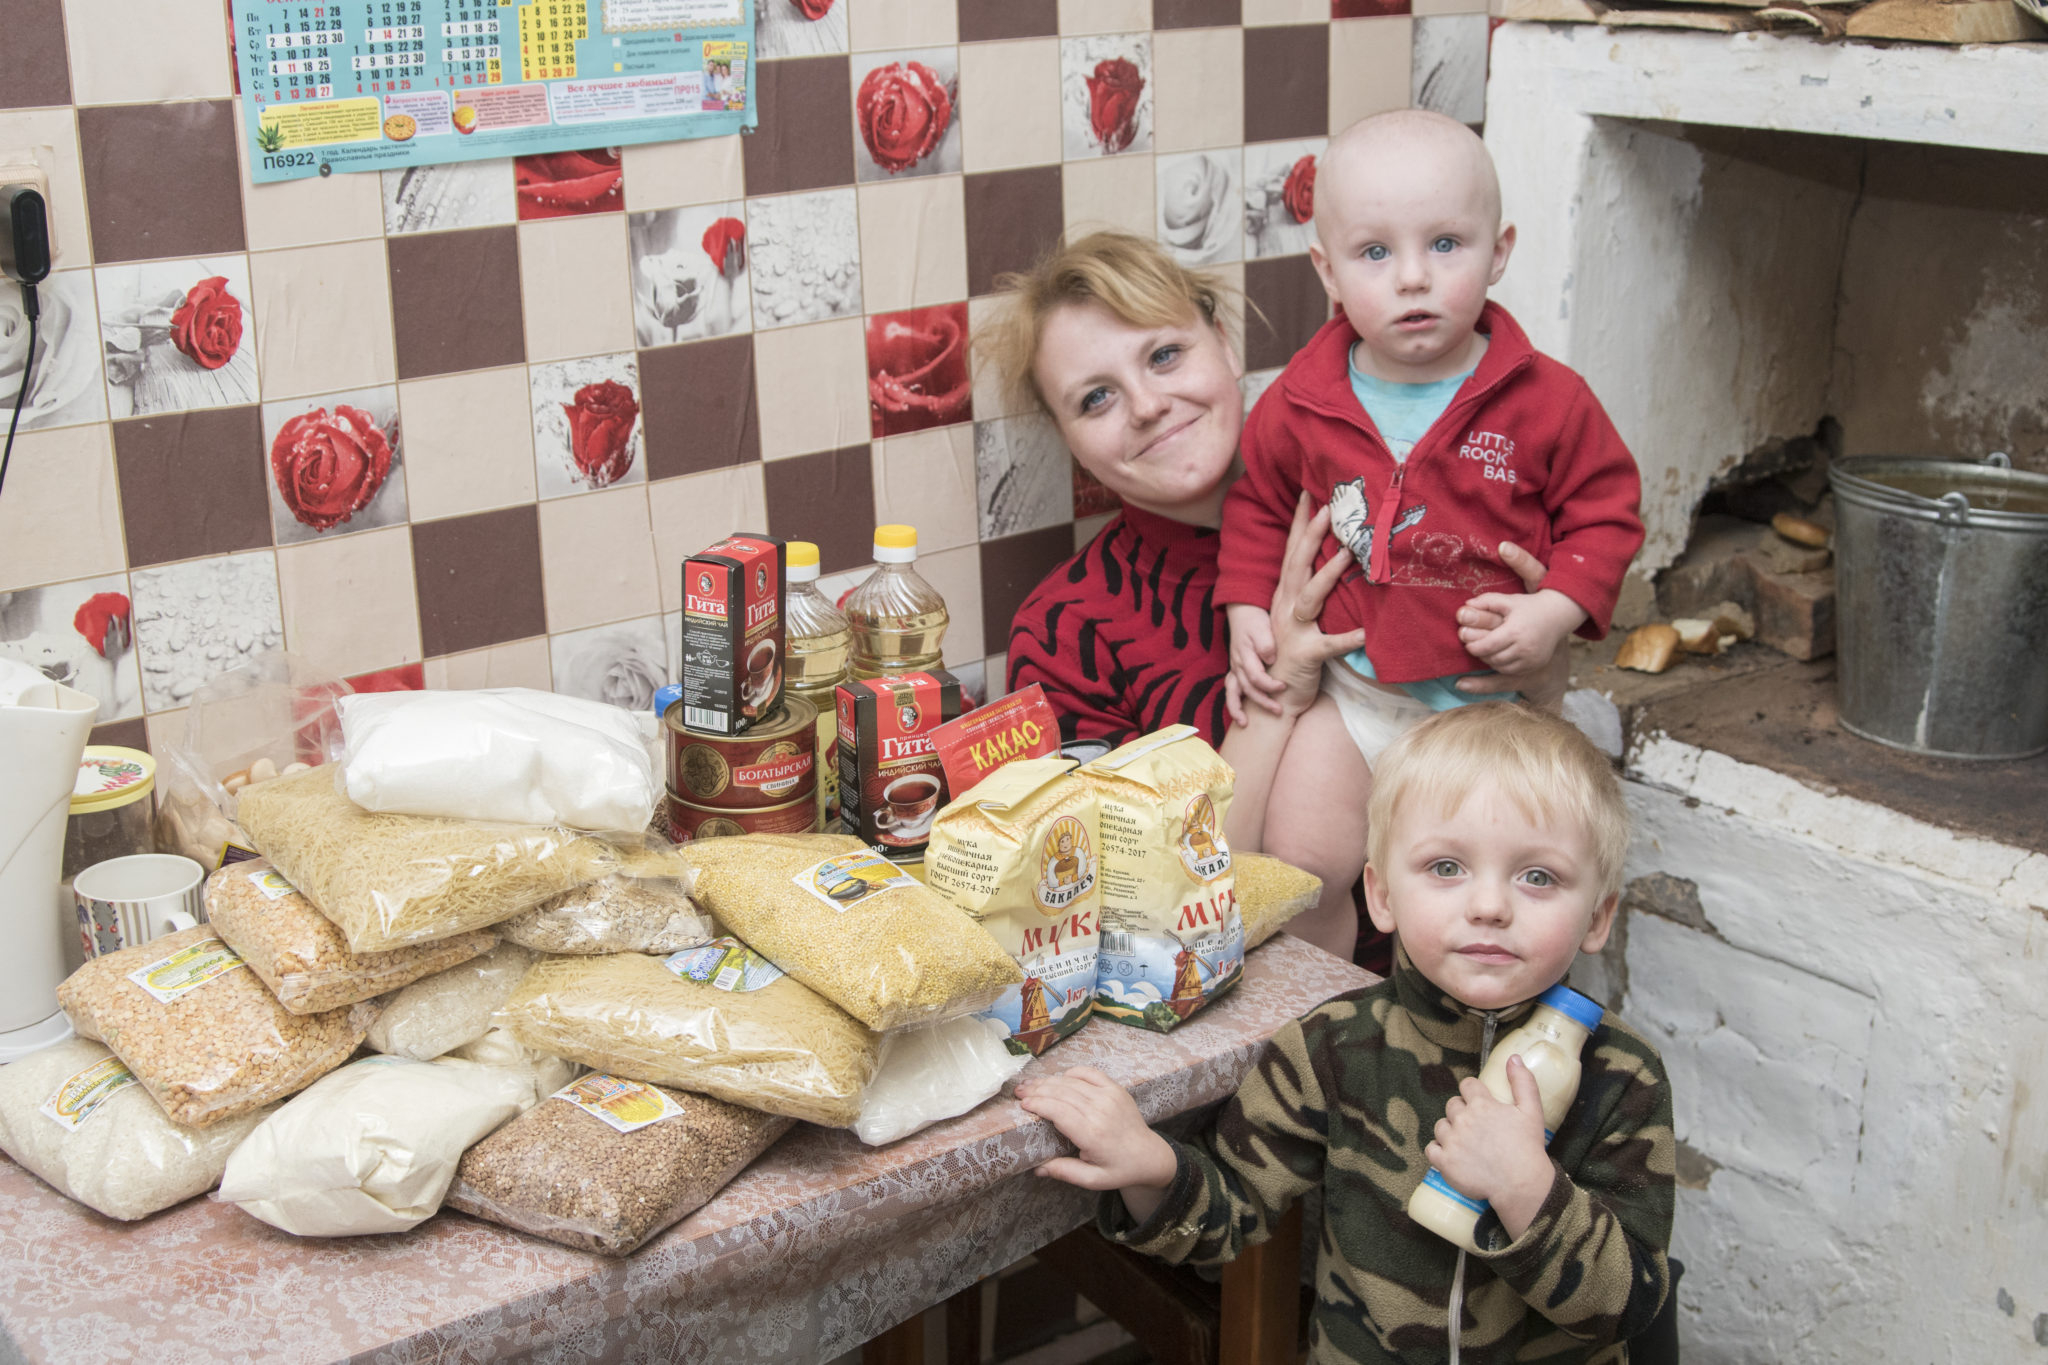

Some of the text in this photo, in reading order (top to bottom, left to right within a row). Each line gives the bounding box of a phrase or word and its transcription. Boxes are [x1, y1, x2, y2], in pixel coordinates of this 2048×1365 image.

[300, 6, 340, 18] 14 21 28
[382, 3, 390, 12] 12
[397, 2, 405, 12] 19
[411, 1, 420, 11] 26
[549, 4, 585, 15] 15 22 29
[383, 16, 391, 26] 13
[397, 15, 407, 25] 20
[412, 14, 420, 24] 27
[460, 10, 496, 20] 10 17 24
[300, 22, 310, 31] 15
[316, 21, 326, 30] 22
[331, 20, 341, 30] 29
[461, 22, 497, 33] 11 18 25
[550, 17, 586, 27] 16 23 30
[384, 28, 422, 39] 14 21 28
[537, 30, 585, 41] 10 17 24 31
[250, 40, 259, 50] Ср
[302, 36, 310, 45] 16
[317, 34, 327, 44] 23
[332, 33, 342, 42] 30
[384, 43, 392, 52] 15
[399, 42, 408, 51] 22
[413, 41, 423, 50] 29
[461, 35, 498, 46] 12 19 26
[462, 48, 497, 59] 13 20 27
[538, 43, 573, 53] 11 18 25
[250, 54, 263, 62] Чт
[287, 50, 296, 59] 10
[303, 49, 310, 58] 17
[318, 48, 328, 57] 24
[385, 56, 393, 65] 16
[399, 55, 409, 63] 23
[414, 54, 423, 62] 30
[538, 55, 574, 66] 12 19 26
[288, 64, 296, 72] 11
[304, 62, 312, 71] 18
[319, 61, 329, 70] 25
[463, 60, 499, 71] 14 21 28
[371, 66, 423, 79] 10 17 24 31
[464, 72, 500, 84] 15 22 29
[539, 67, 574, 78] 13 20 27
[289, 76, 298, 86] 12
[305, 75, 313, 84] 19
[320, 74, 330, 84] 26
[372, 80, 410, 92] 11 18 25
[587, 84, 622, 92] лучшее
[625, 77, 676, 88] любимым!
[290, 87, 329, 99] 13 20 27
[674, 84, 700, 95] ПР015
[322, 151, 410, 163] Православные праздники
[342, 147, 378, 155] Календарь
[263, 152, 315, 169] П6922
[1459, 445, 1509, 466] ROCK
[687, 594, 725, 614] Гита
[747, 599, 775, 626] Гита
[685, 616, 716, 626] ИНДИЙСКИЙ
[838, 718, 855, 742] Гита
[900, 733, 928, 741] принцес
[882, 738, 935, 759] Гита
[739, 756, 811, 781] БОГАТЫРСКАЯ
[878, 762, 927, 777] ИНДИЙСКИЙ
[766, 779, 796, 790] СВИНИНА
[1100, 822, 1142, 836] опекарная
[1119, 836, 1138, 846] сорт
[1102, 843, 1146, 858] 26574-2017
[937, 862, 994, 883] высший сорт
[930, 869, 949, 883] ГОСТ
[952, 878, 1000, 895] 26574-2017
[1044, 873, 1094, 904] БАКАЛЕЯ
